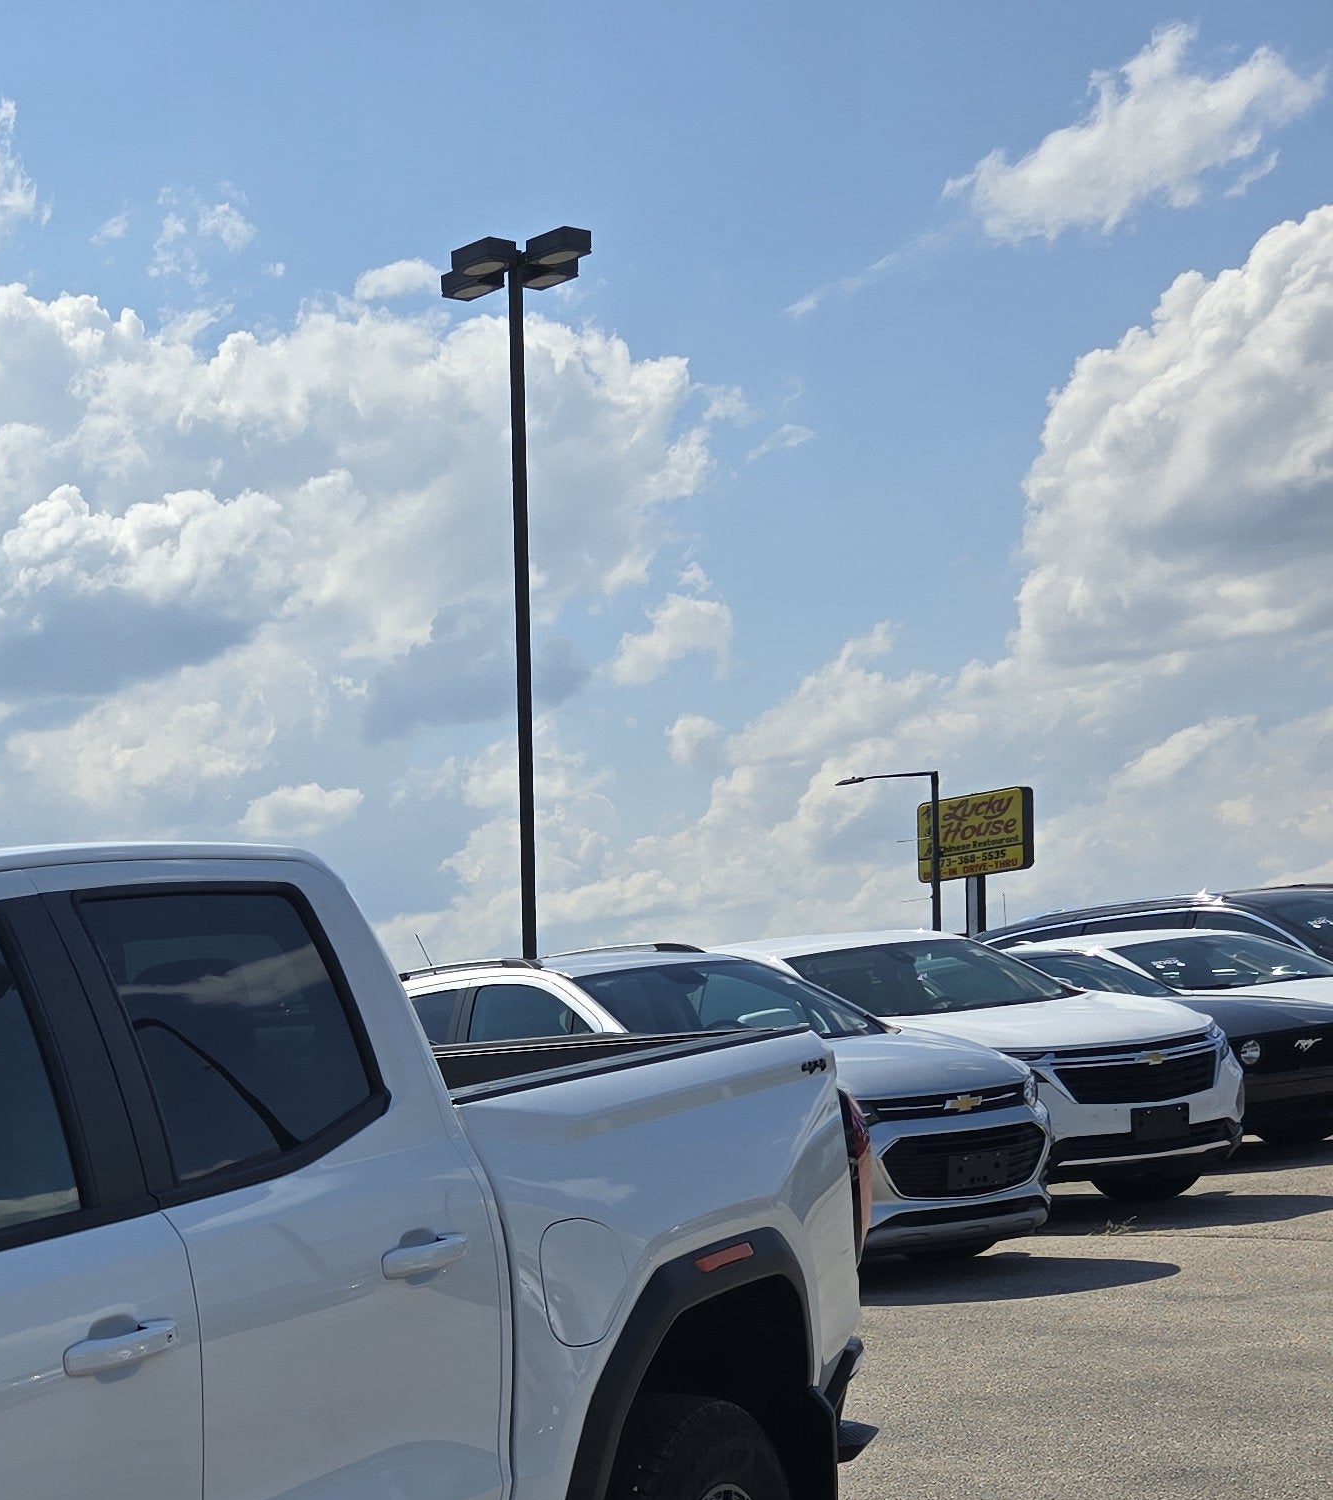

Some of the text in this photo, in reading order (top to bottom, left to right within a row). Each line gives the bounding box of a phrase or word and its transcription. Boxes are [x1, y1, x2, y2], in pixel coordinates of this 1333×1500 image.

[942, 795, 1015, 822] Lucky
[940, 817, 1017, 843] House
[940, 849, 1007, 868] 73-368-5535
[963, 857, 1018, 874] DRIVE-THRU
